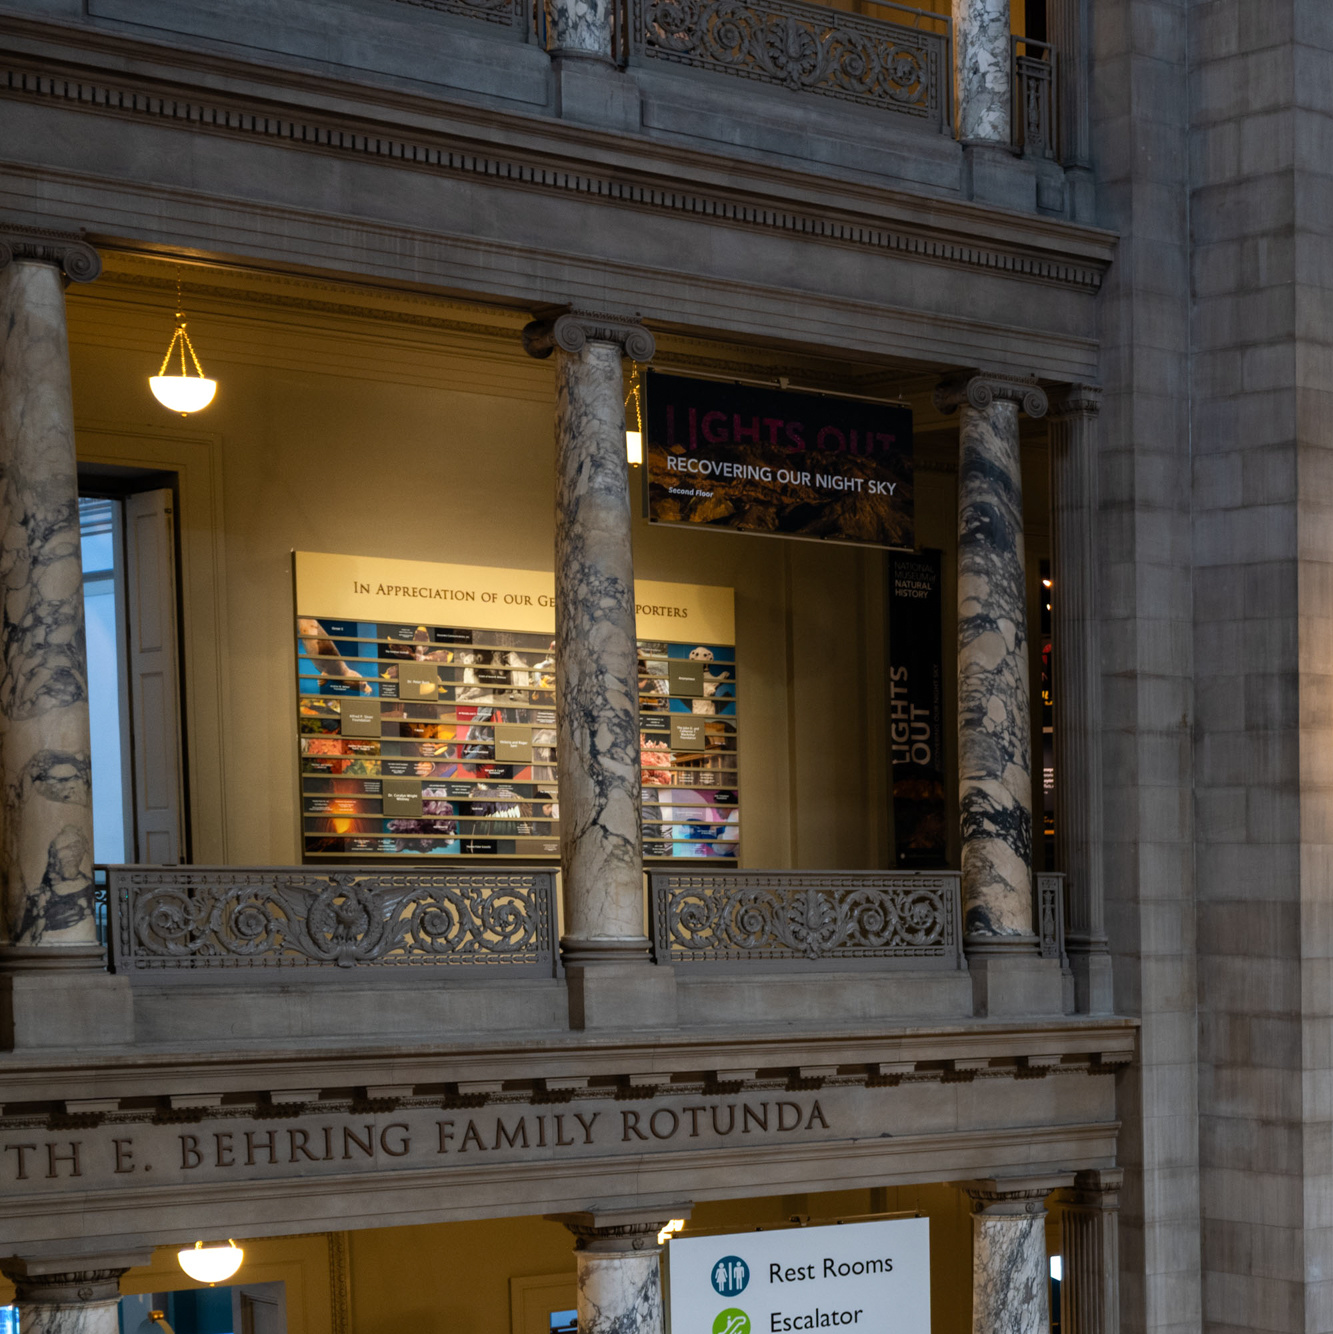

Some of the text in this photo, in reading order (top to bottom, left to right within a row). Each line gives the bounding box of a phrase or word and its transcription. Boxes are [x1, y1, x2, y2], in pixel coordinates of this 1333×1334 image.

[666, 456, 897, 496] RECOVERING OUR NIGHT SKY
[668, 487, 714, 498] Second Floor
[894, 580, 932, 590] NATURAL
[894, 589, 929, 599] HISTORY
[890, 665, 910, 764] LIGHTS
[910, 703, 932, 765] OUT
[112, 1138, 152, 1173] E.
[178, 1123, 411, 1170] BEHRING
[436, 1111, 601, 1154] FAMILY
[620, 1100, 830, 1142] ROTUNDA
[769, 1257, 893, 1283] Rest Rooms
[770, 1308, 863, 1333] Escalator
